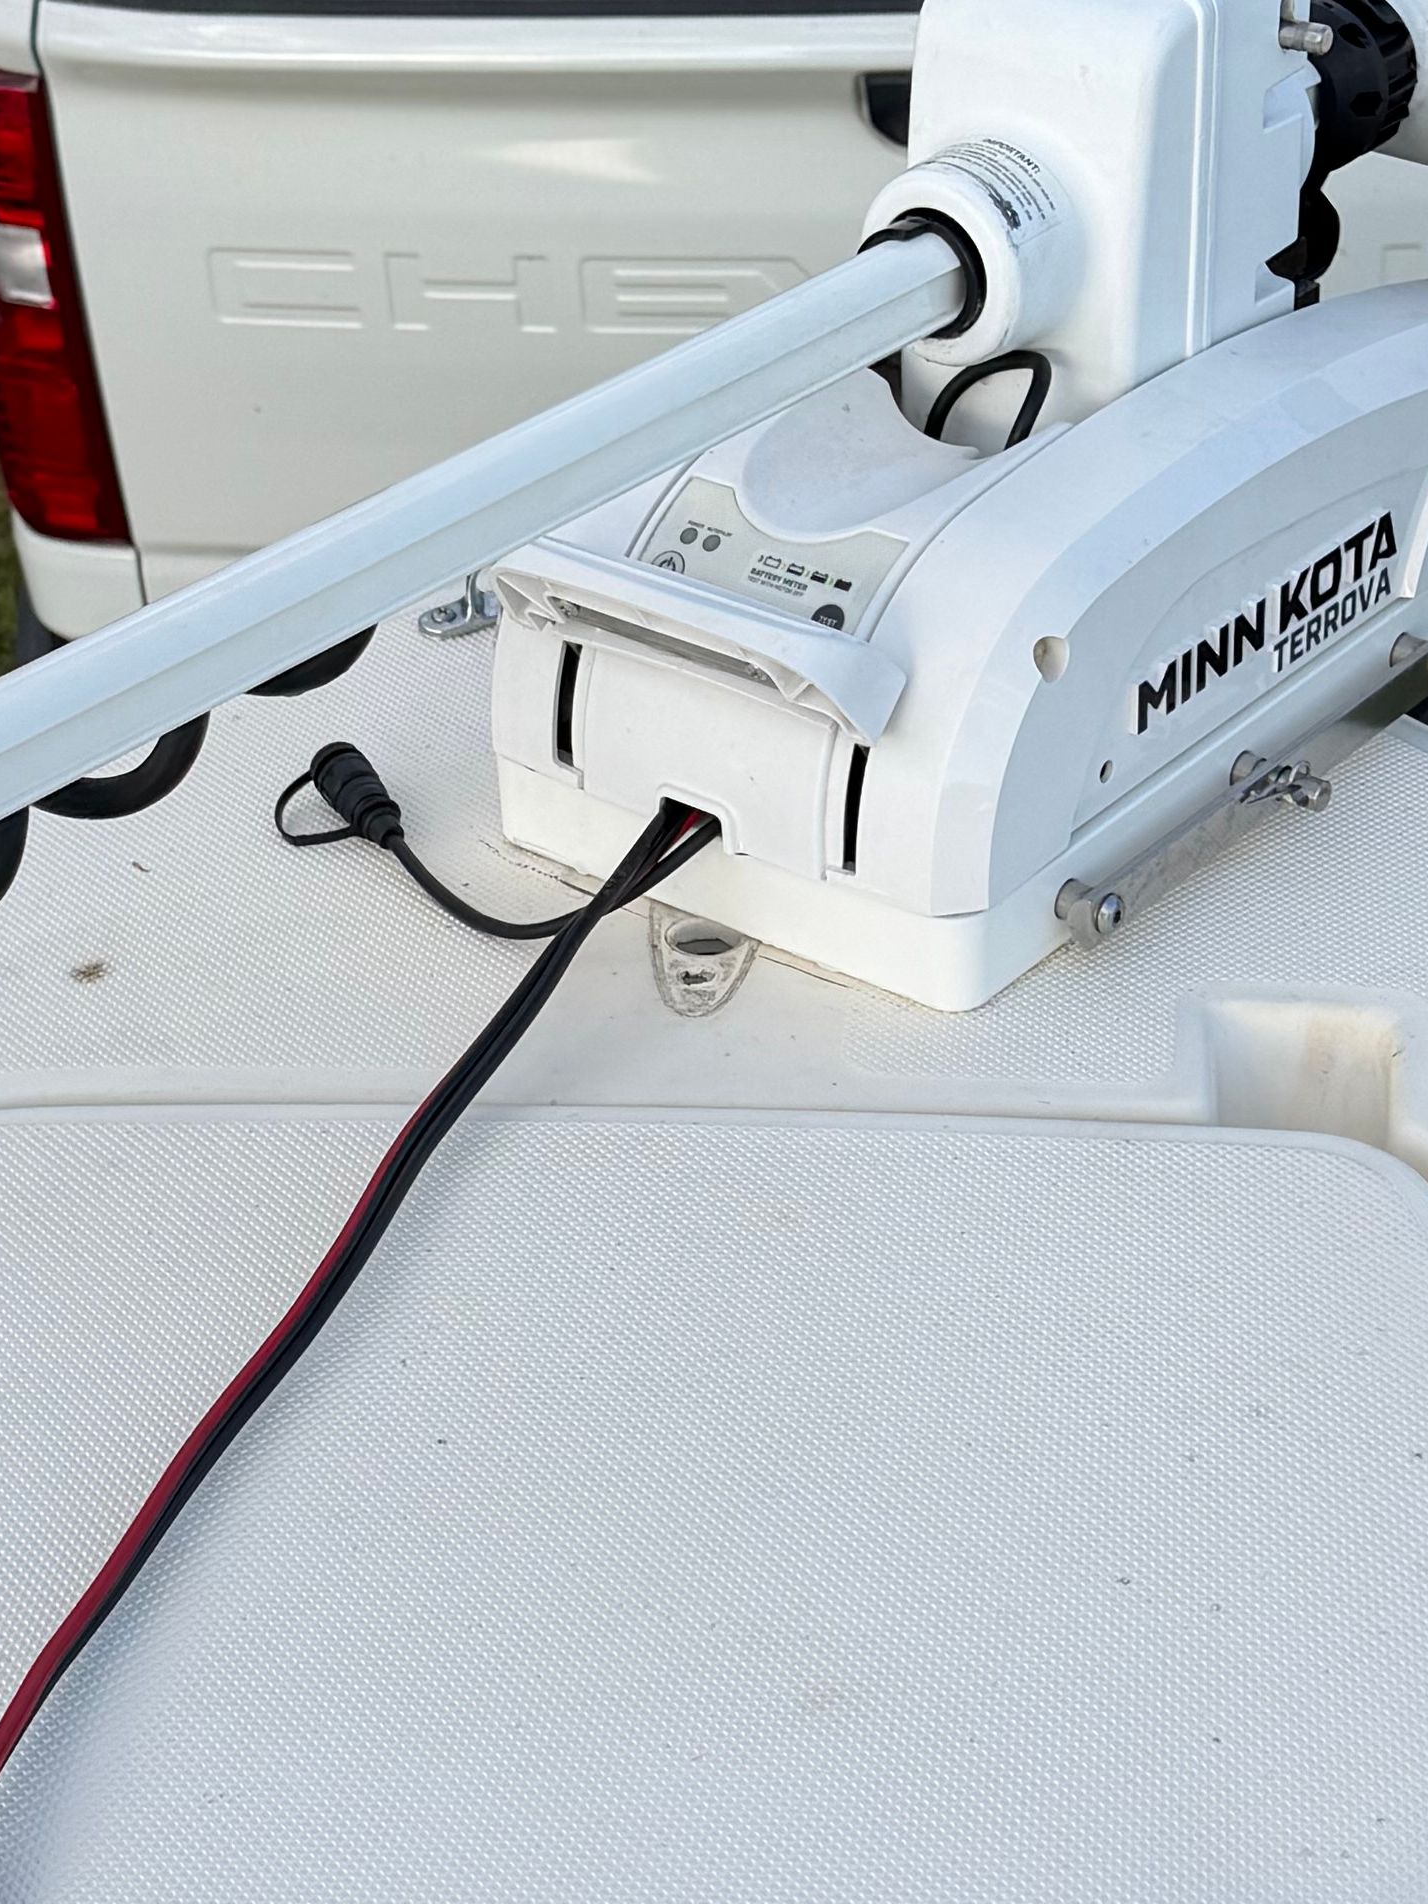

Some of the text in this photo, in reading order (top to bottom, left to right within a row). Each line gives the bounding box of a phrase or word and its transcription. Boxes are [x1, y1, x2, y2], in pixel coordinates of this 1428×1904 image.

[750, 567, 809, 592] BATTERY METER
[1135, 510, 1399, 736] MINN KOTA
[1272, 566, 1392, 674] TERROVA
